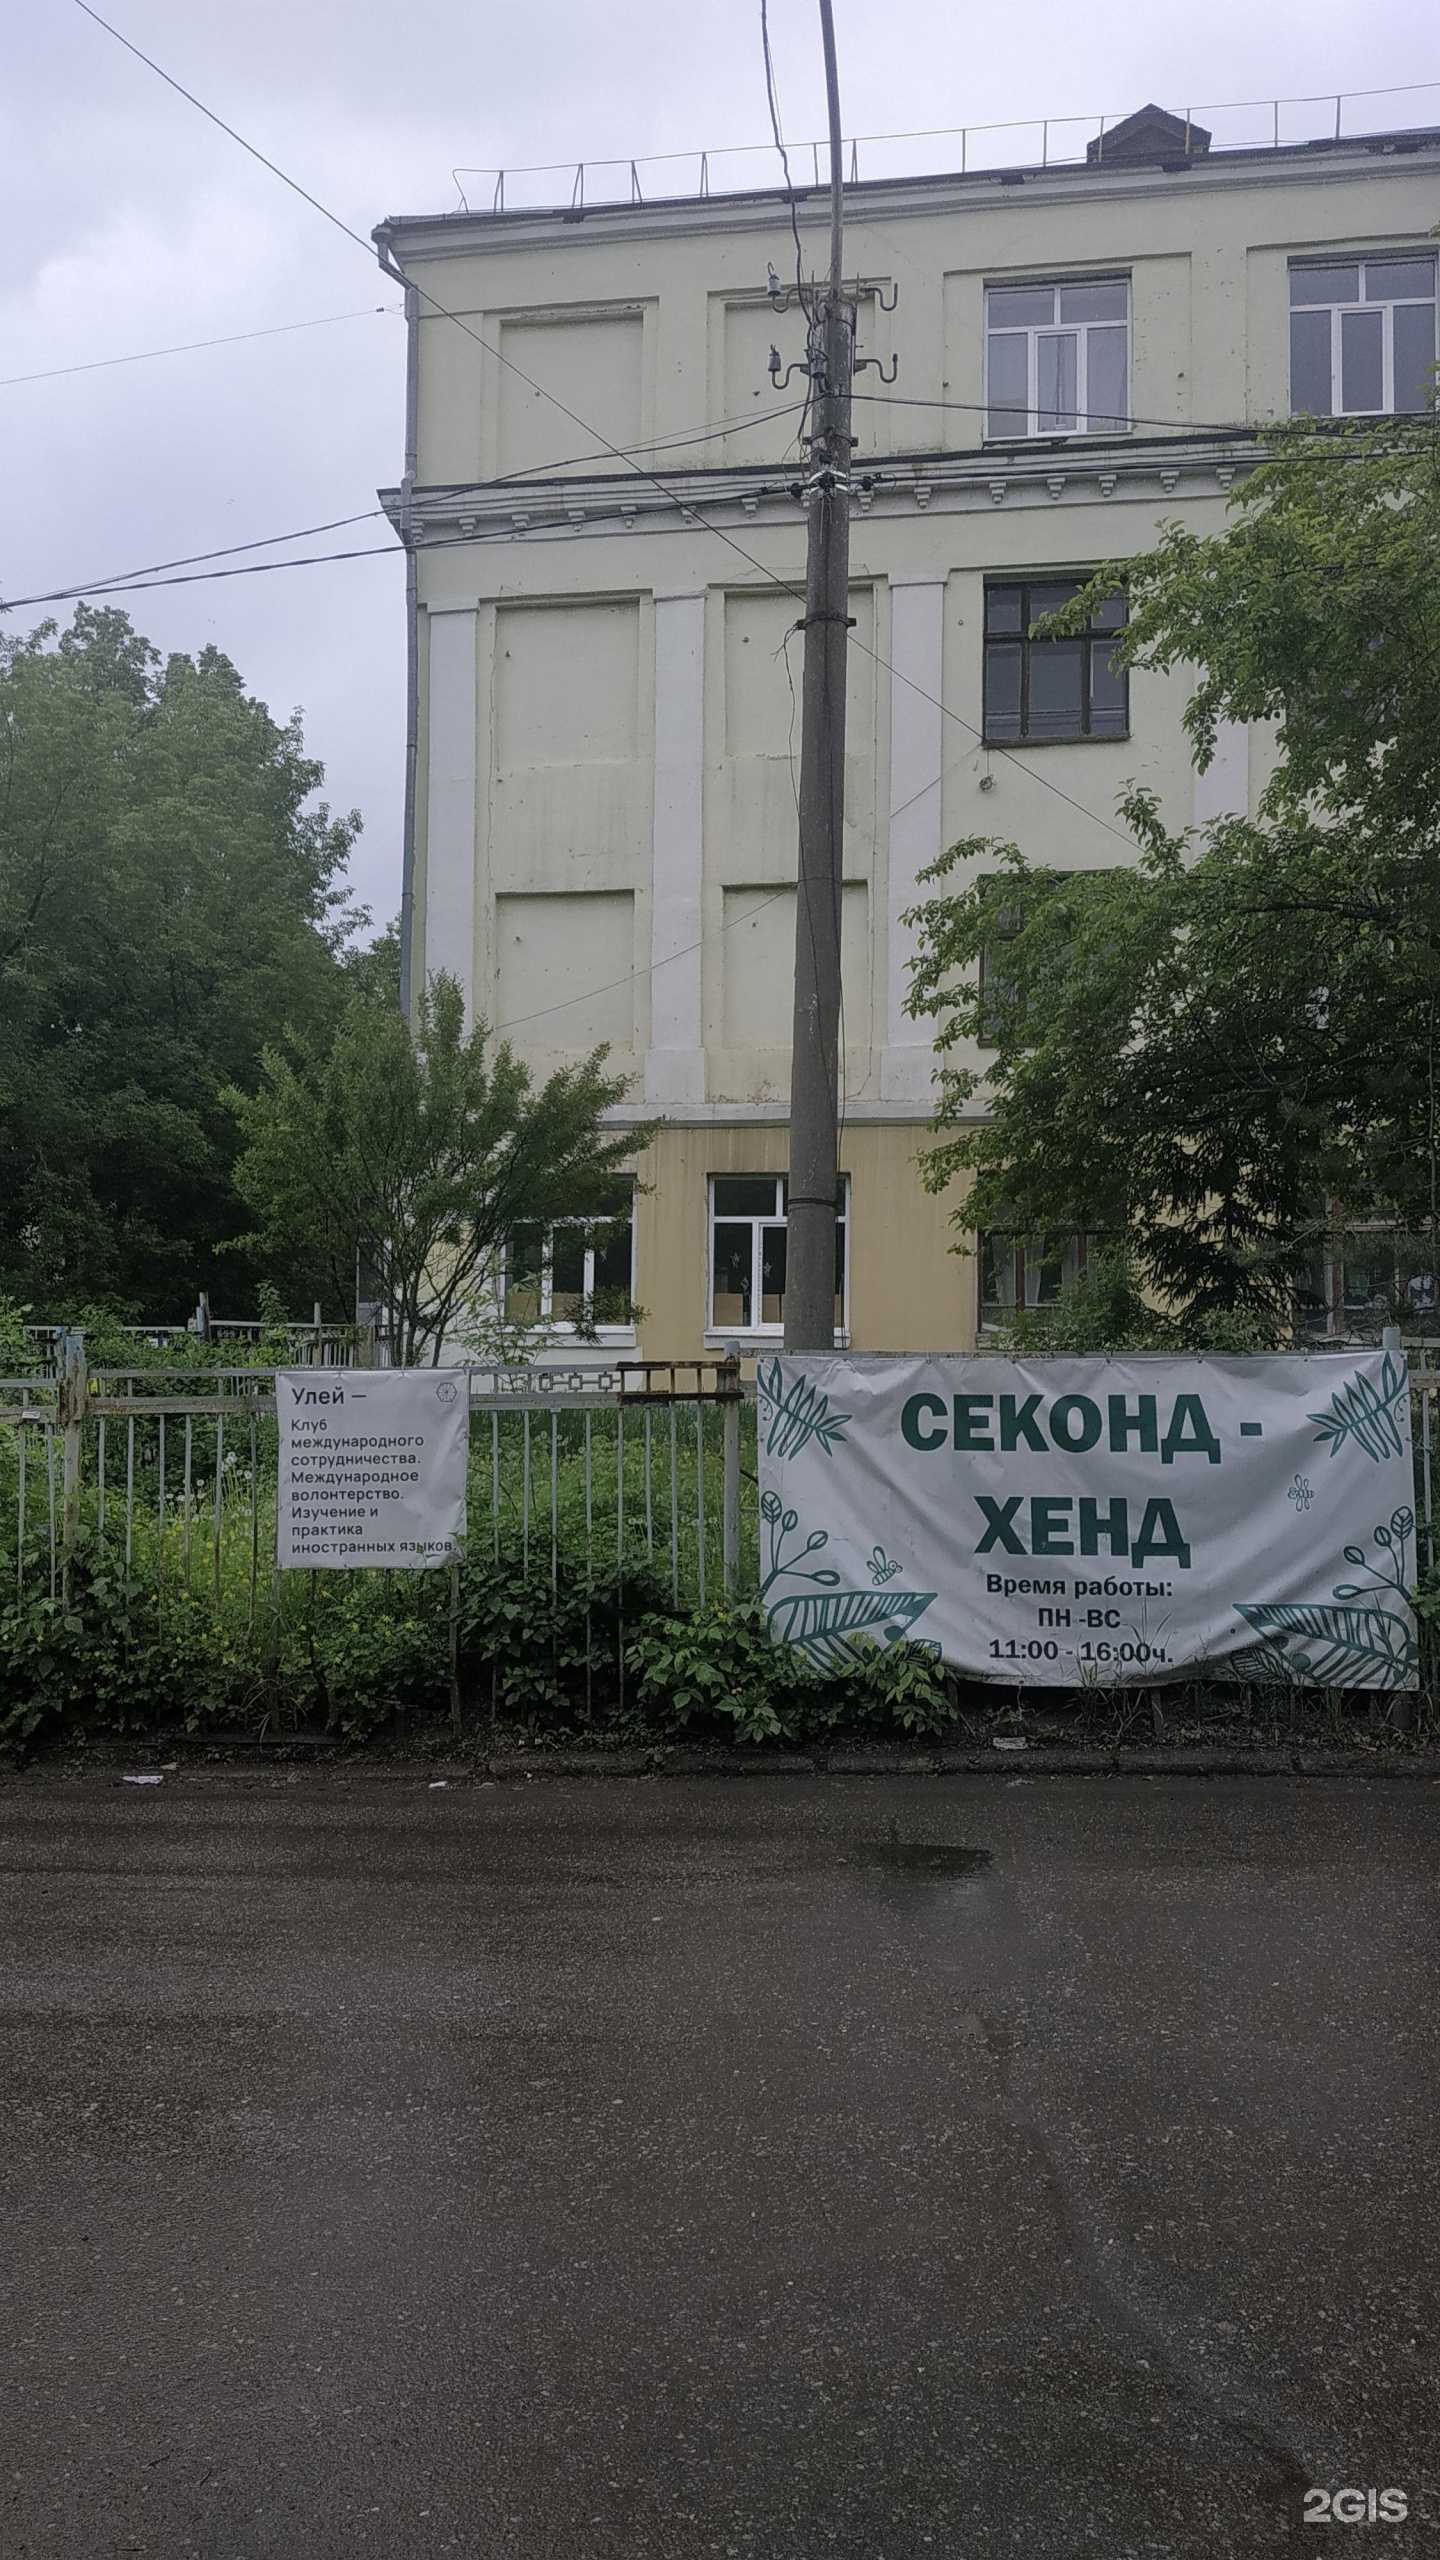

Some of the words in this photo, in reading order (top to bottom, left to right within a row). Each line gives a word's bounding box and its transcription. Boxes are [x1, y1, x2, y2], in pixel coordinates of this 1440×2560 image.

[291, 1386, 345, 1405] Улей
[291, 1418, 328, 1434] Клуб
[900, 1392, 1221, 1464] СЕКОНД
[291, 1435, 424, 1451] международного
[291, 1453, 421, 1469] сотрудничества.
[291, 1470, 419, 1486] Международное
[291, 1488, 404, 1503] волонтерство.
[291, 1506, 366, 1522] Изучение
[370, 1508, 378, 1518] и
[291, 1525, 363, 1540] практика
[973, 1496, 1191, 1568] ХЕНД
[291, 1542, 396, 1557] иностранных
[986, 1574, 1066, 1597] Время
[1074, 1576, 1172, 1599] работы:
[1038, 1608, 1071, 1627] ПН
[989, 1639, 1058, 1660] 11:00
[1080, 1641, 1173, 1663] 16:00ч.
